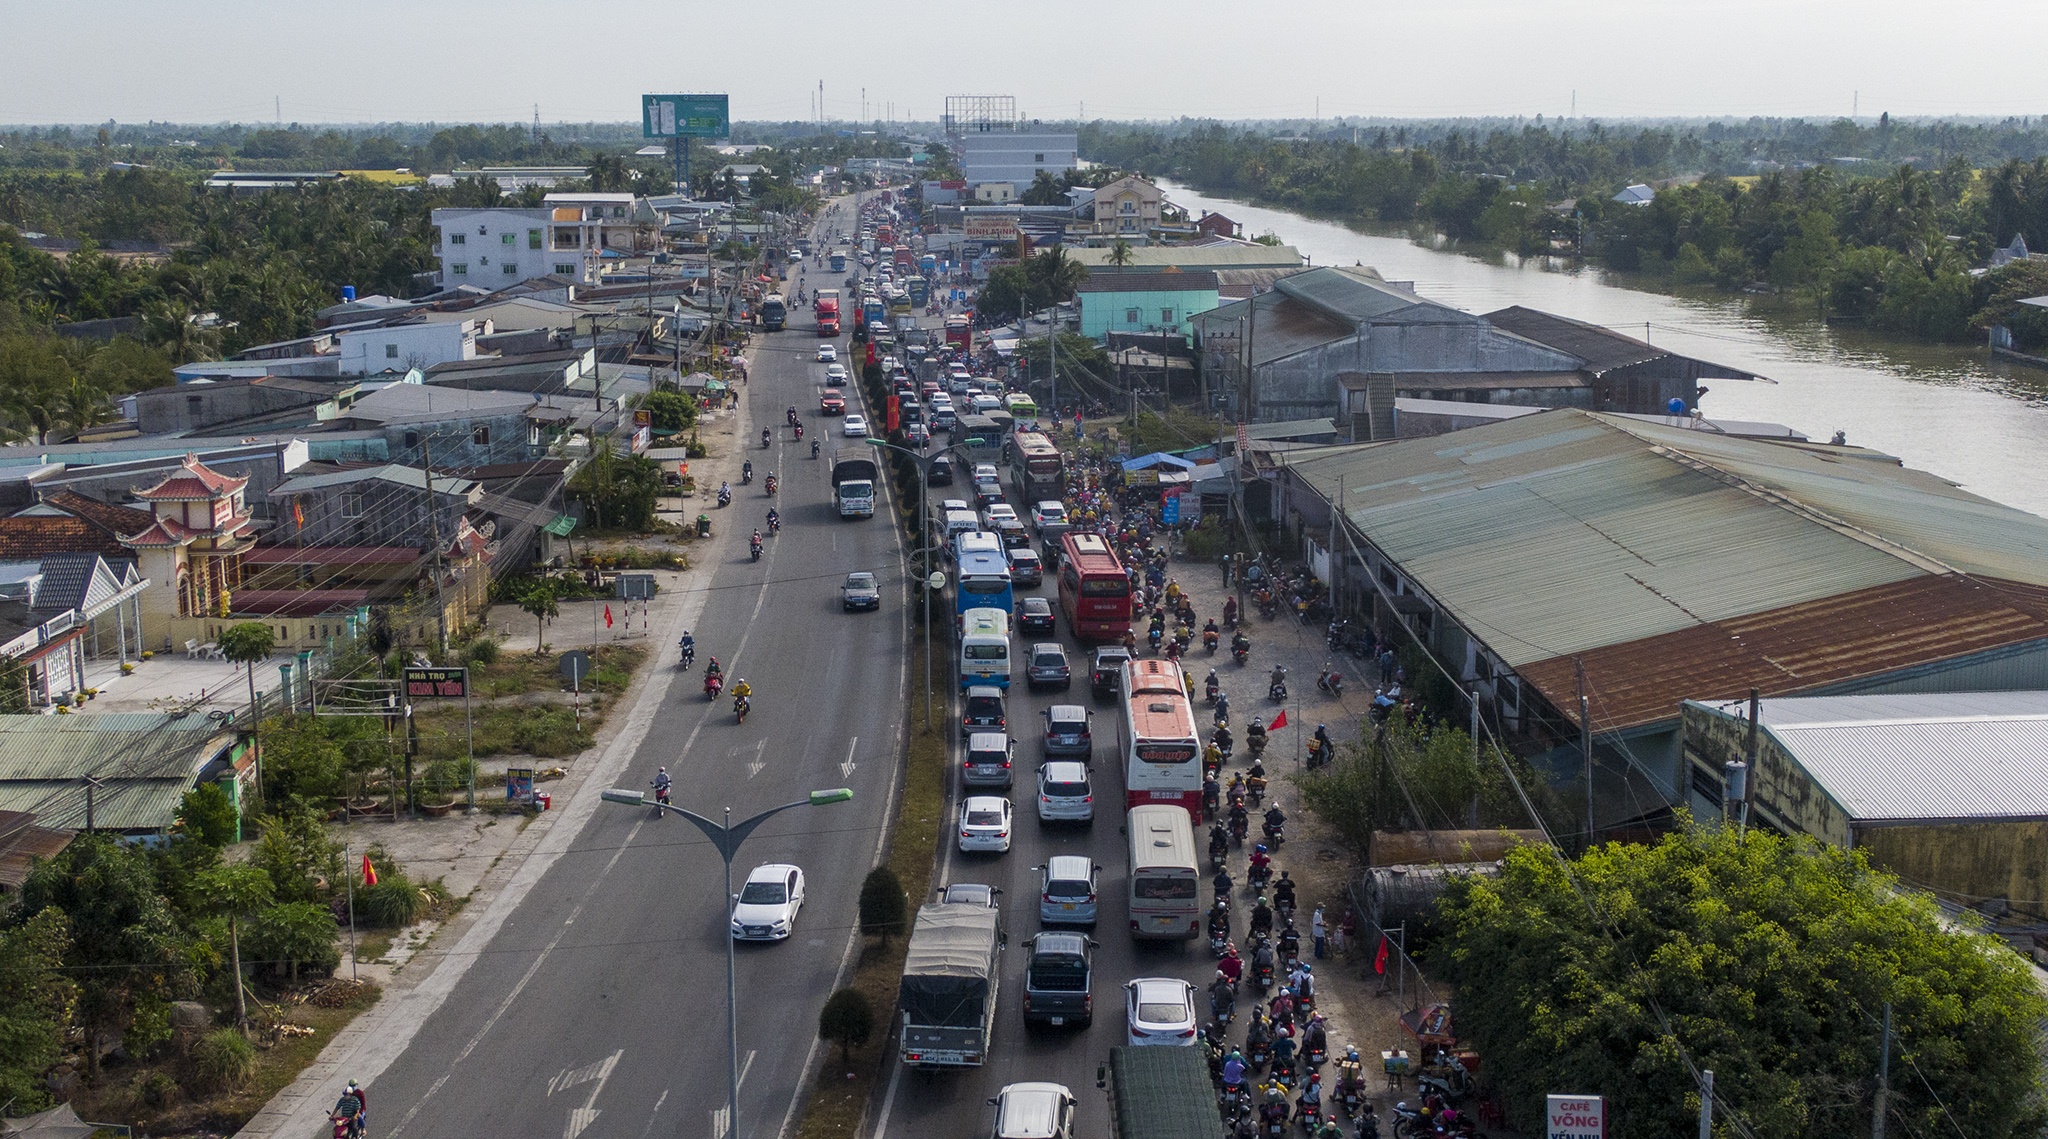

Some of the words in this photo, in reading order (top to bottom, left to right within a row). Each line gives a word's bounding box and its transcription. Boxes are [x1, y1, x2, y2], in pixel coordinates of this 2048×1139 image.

[408, 671, 426, 680] NHÀ
[428, 672, 446, 681] TRỌ
[408, 682, 434, 696] KIM
[435, 679, 463, 696] YẾN
[1560, 1101, 1590, 1111] CAFÉ
[1551, 1112, 1599, 1127] VÕNG
